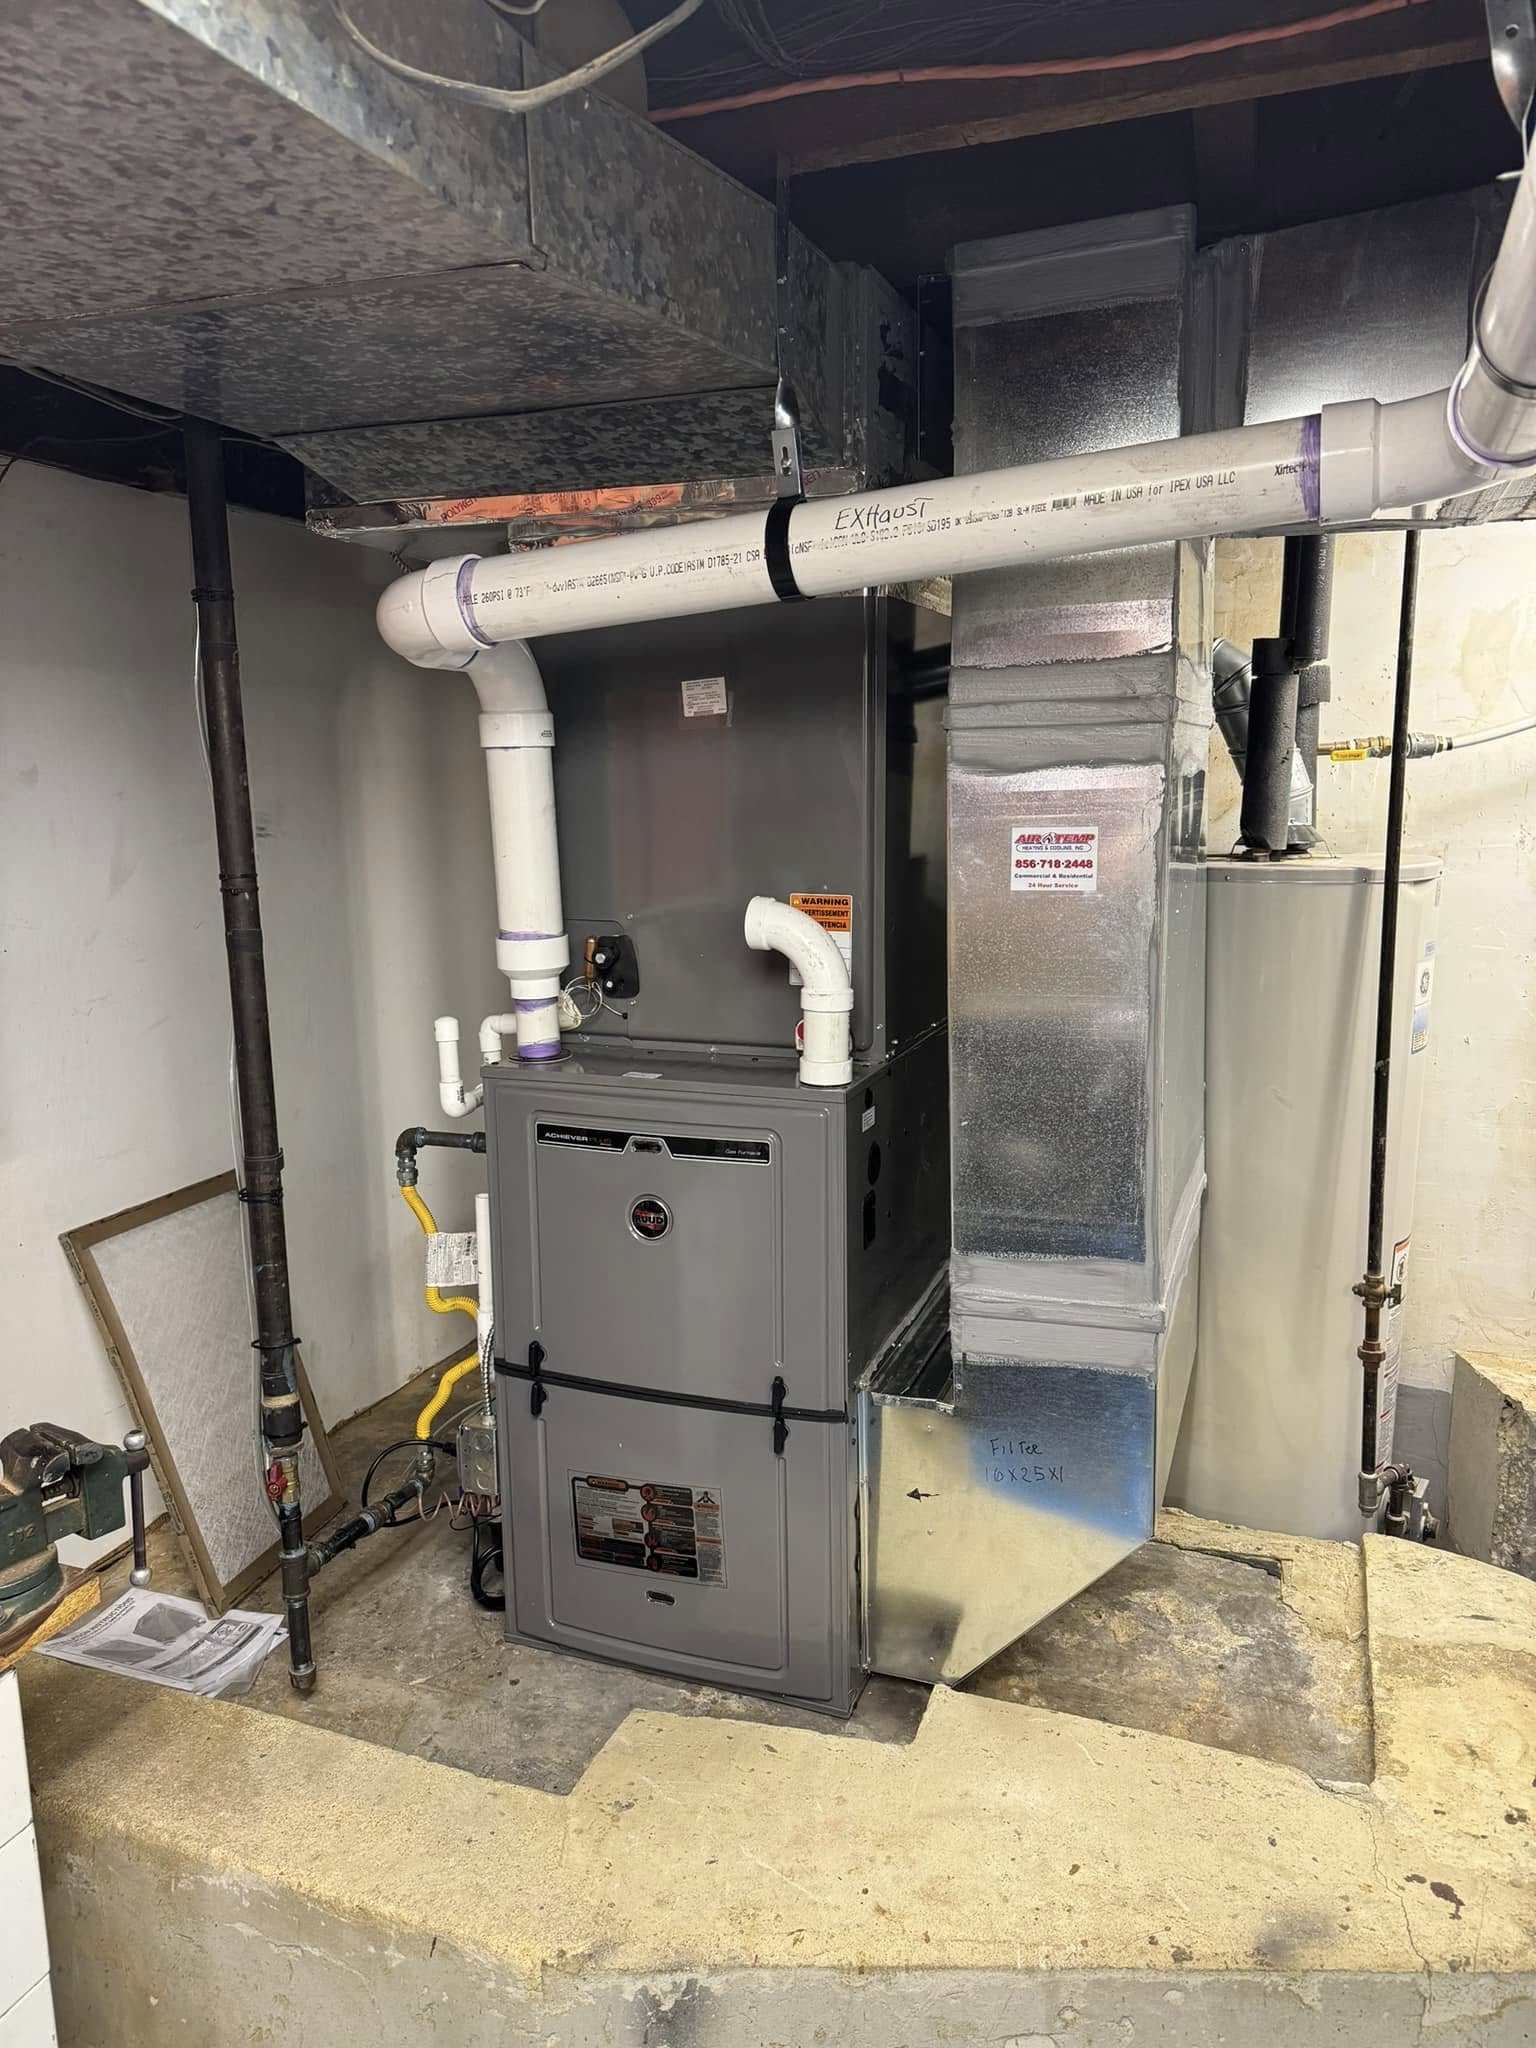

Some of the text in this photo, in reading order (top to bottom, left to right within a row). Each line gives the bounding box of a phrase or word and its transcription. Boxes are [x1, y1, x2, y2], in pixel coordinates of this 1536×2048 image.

[707, 553, 742, 569] D1785-21
[746, 549, 760, 562] CSA
[1083, 493, 1105, 506] MADE
[1111, 489, 1121, 502] IN
[1126, 486, 1143, 500] USA
[1169, 478, 1191, 493] IPEX
[1195, 474, 1214, 489] USA
[1218, 470, 1236, 486] LLC
[1015, 833, 1095, 845] AIR TEMP
[801, 898, 849, 906] WARNING
[545, 1132, 588, 1141] ACHIEVER
